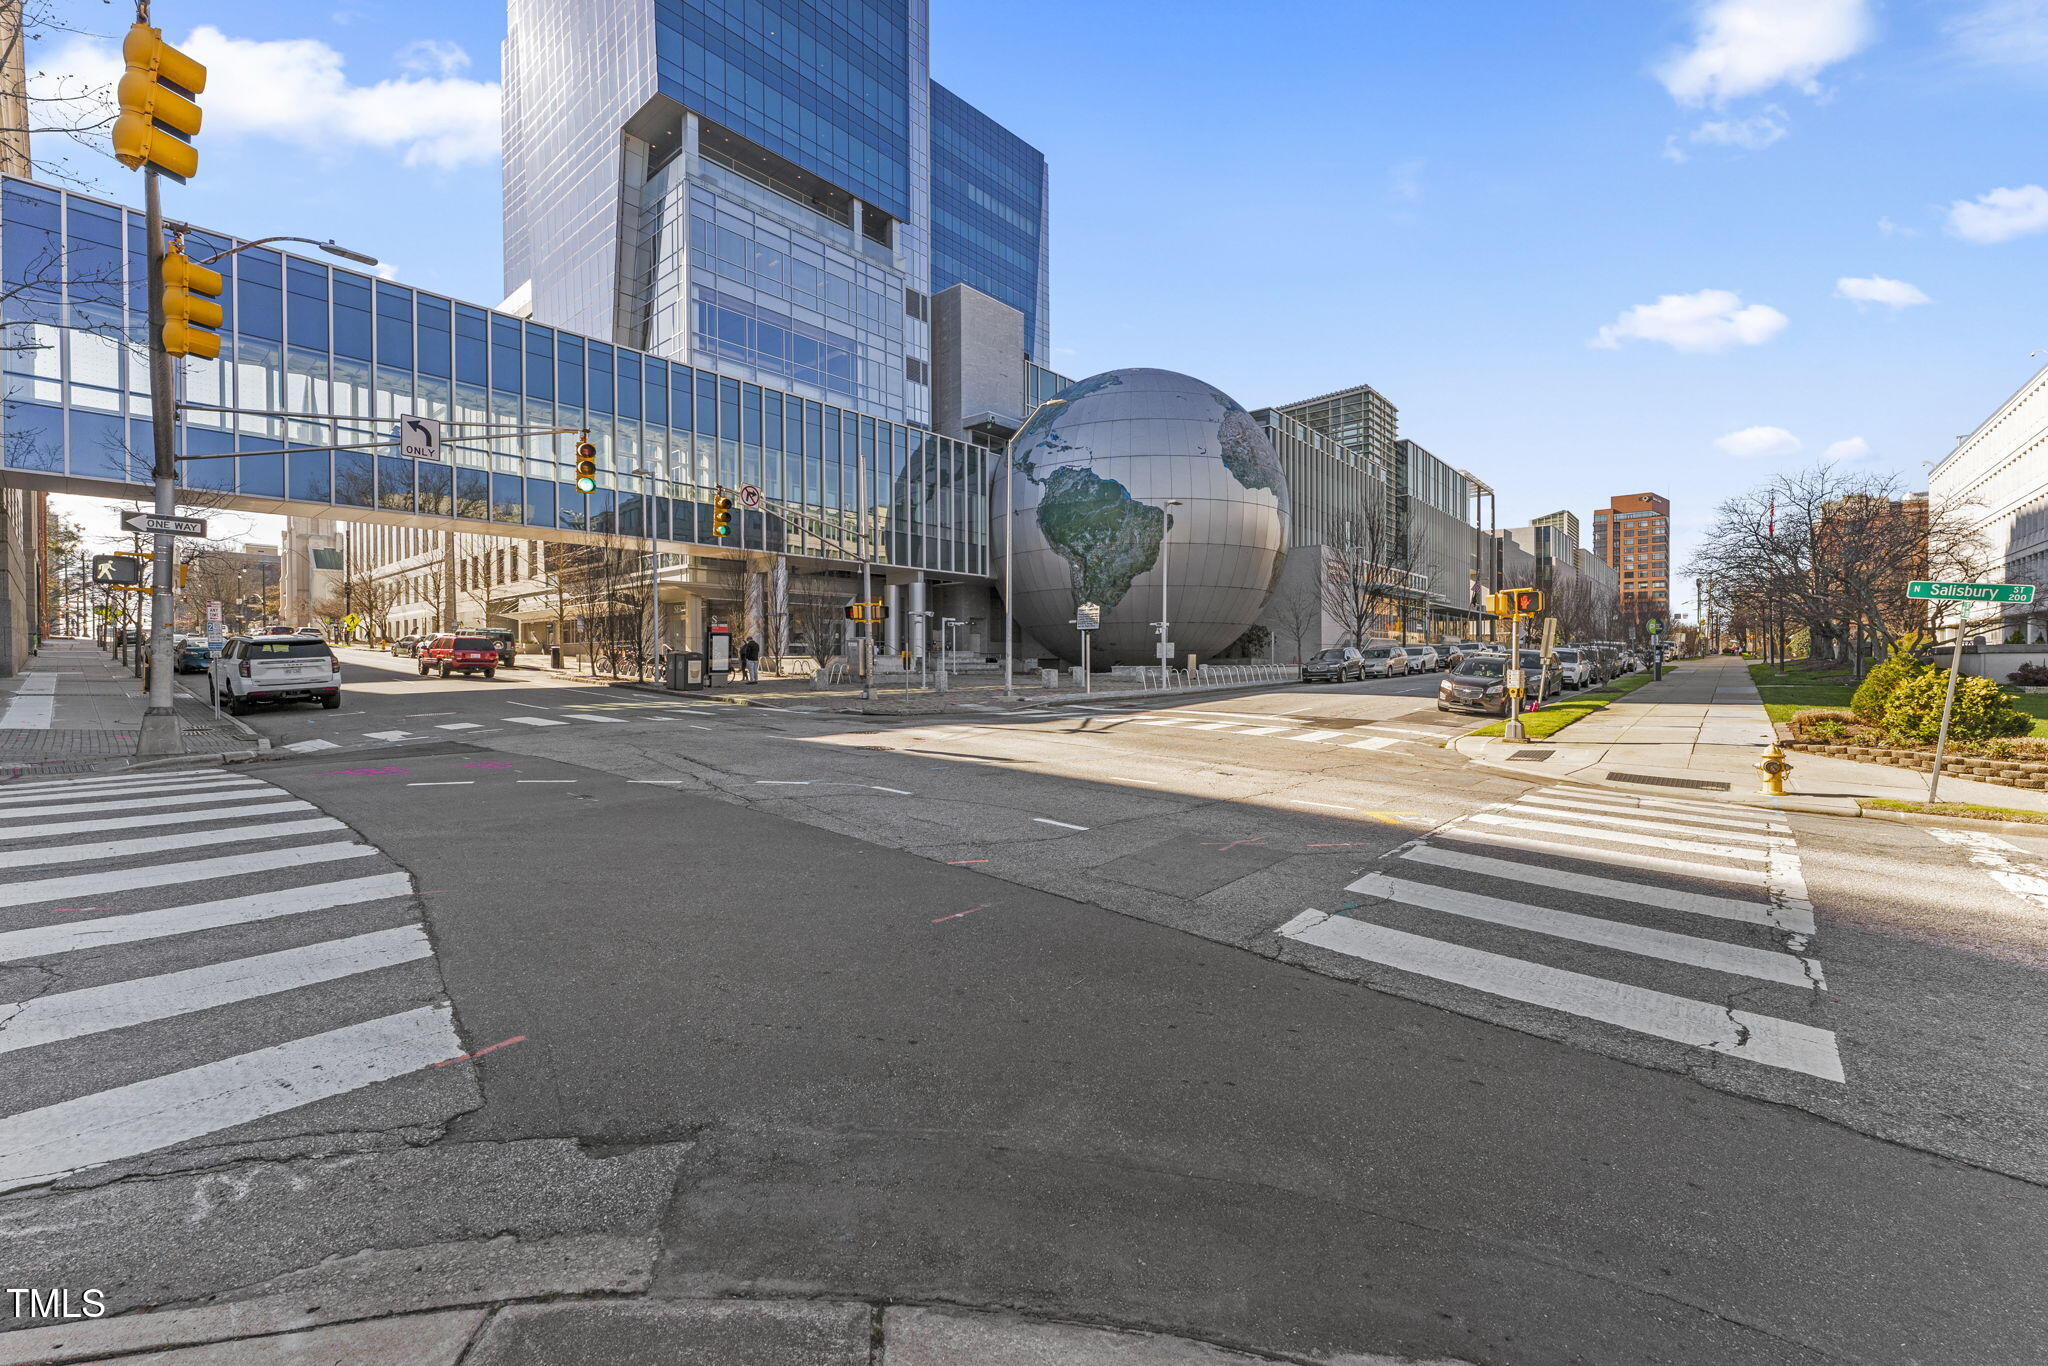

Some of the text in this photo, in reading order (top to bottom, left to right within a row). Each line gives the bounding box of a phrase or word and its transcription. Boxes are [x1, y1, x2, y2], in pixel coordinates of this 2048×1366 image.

[406, 445, 435, 457] ONLY
[147, 519, 198, 531] ONE WAY
[1913, 583, 2026, 600] N Salisbury ST
[208, 623, 213, 631] 2
